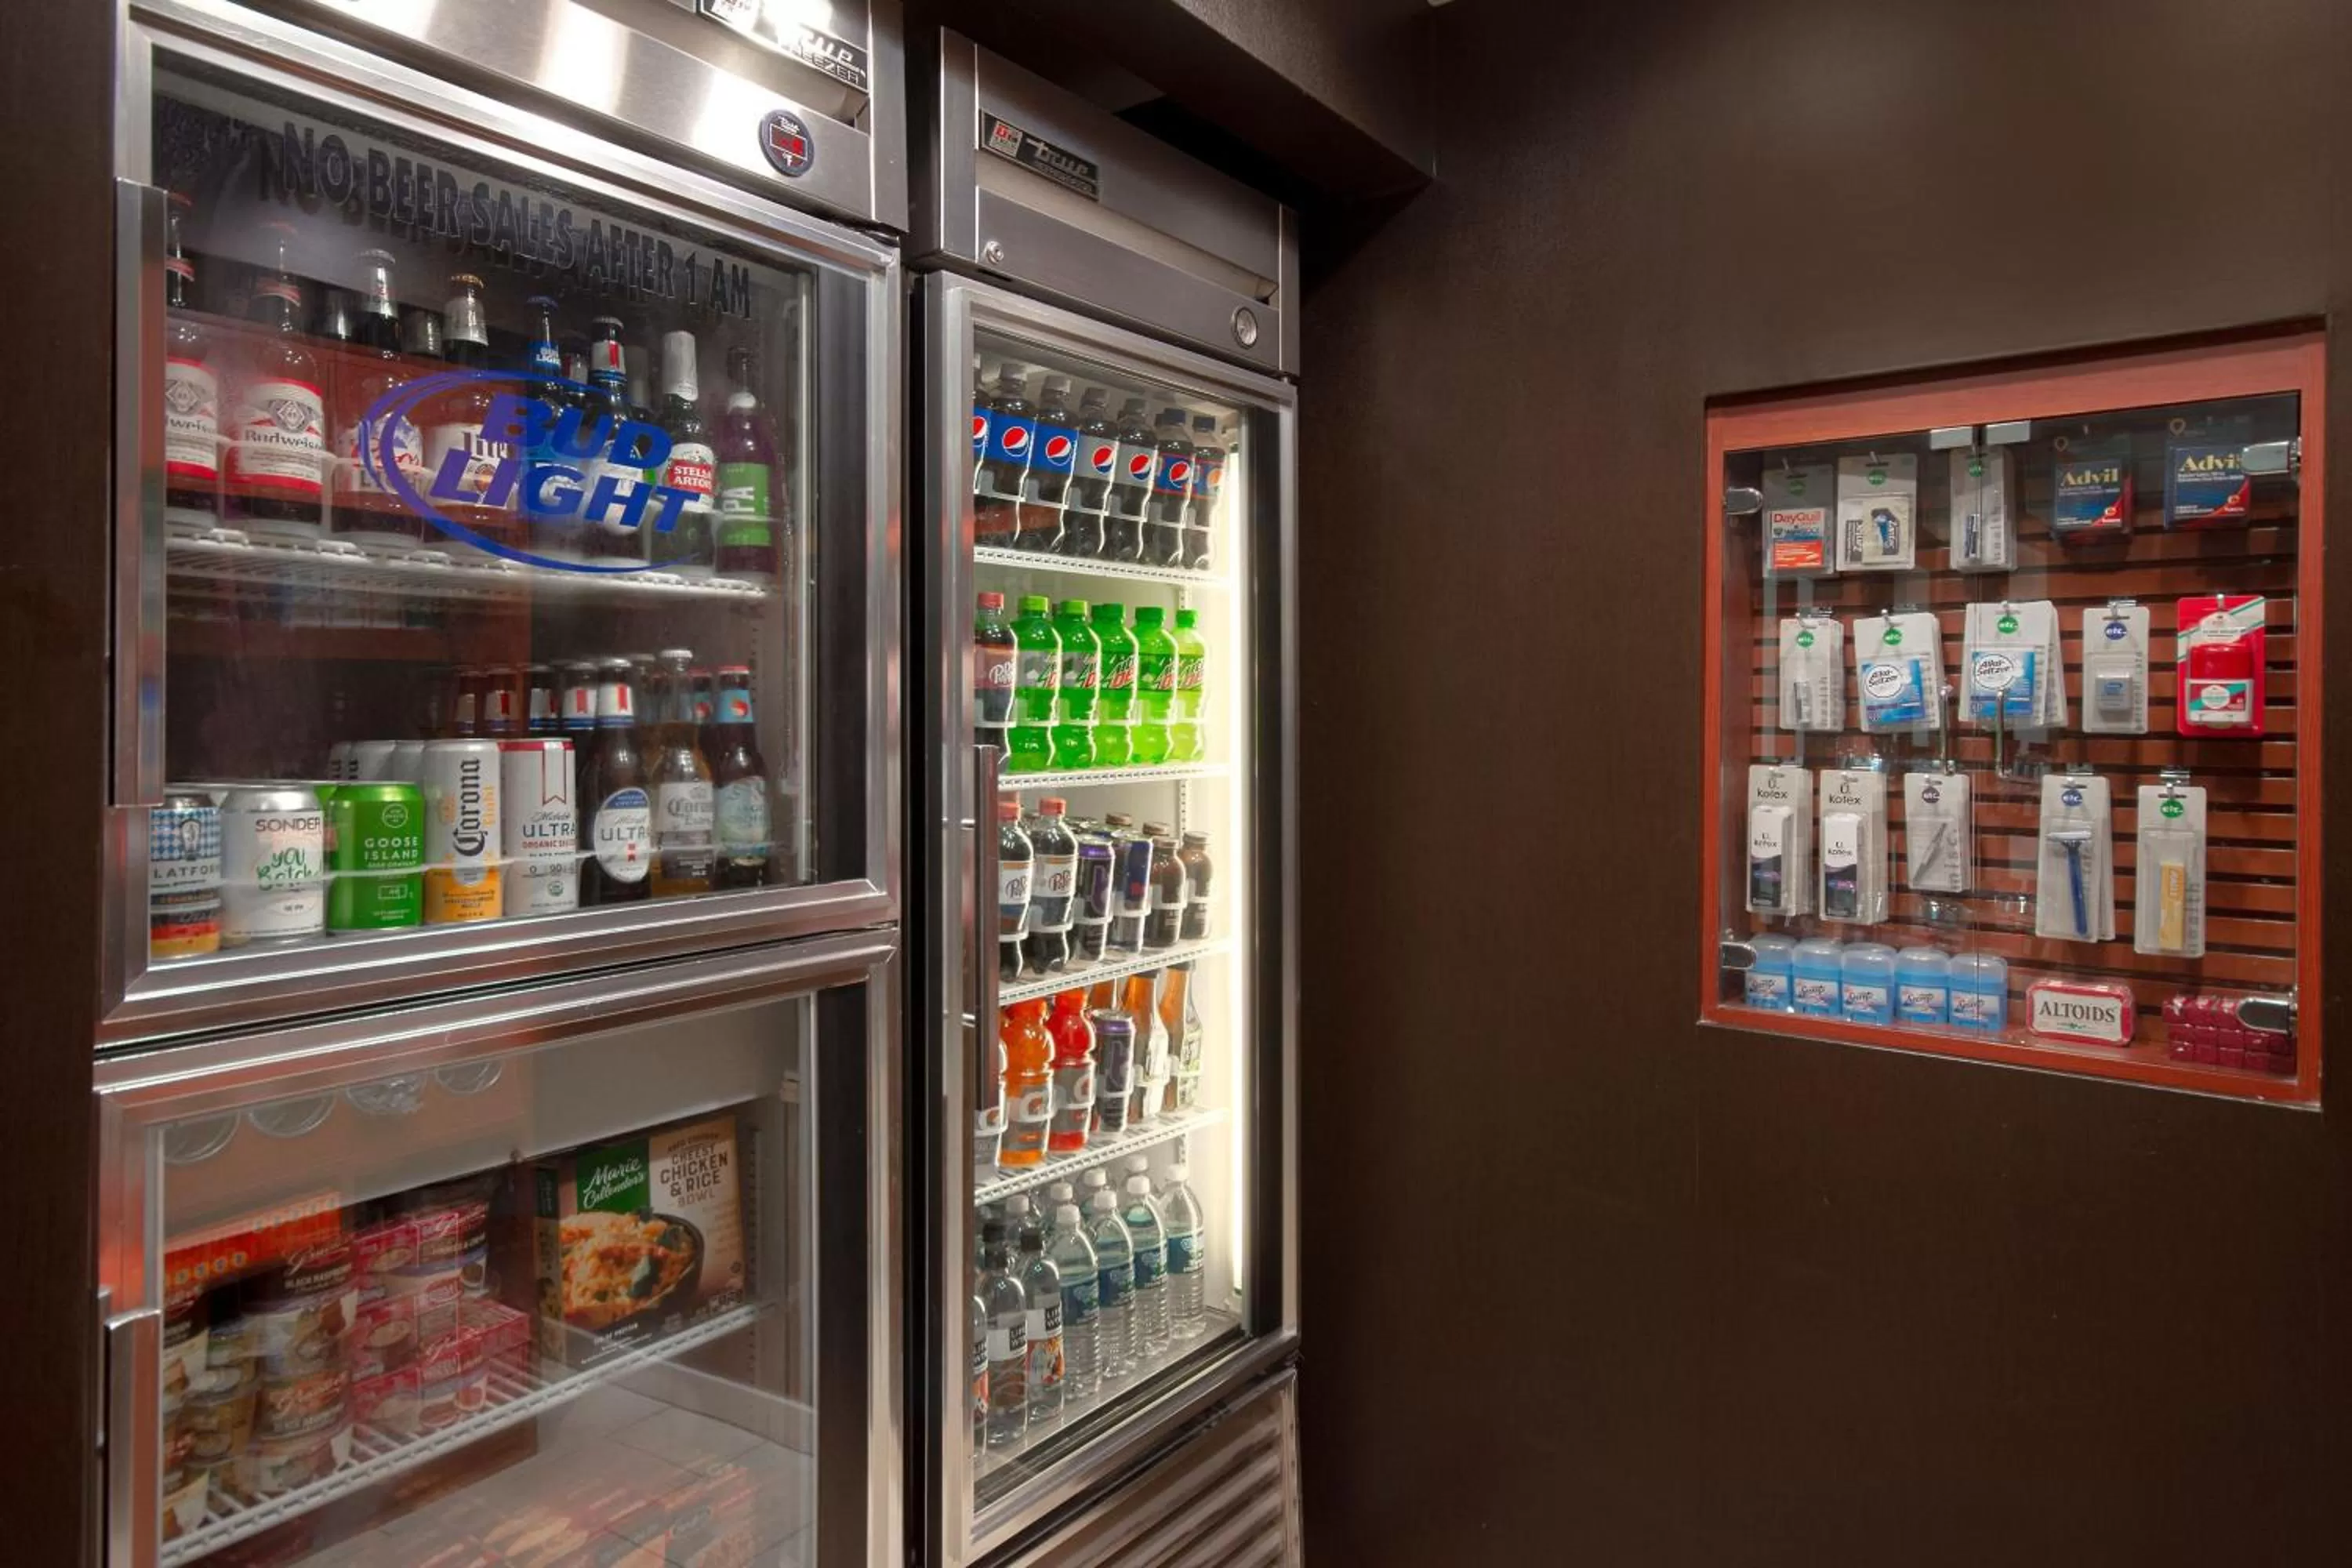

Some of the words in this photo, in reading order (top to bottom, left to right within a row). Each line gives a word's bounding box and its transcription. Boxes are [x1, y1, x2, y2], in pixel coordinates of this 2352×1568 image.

[283, 122, 354, 206] NO
[367, 147, 462, 238] BEER
[470, 182, 575, 270] SALES
[586, 219, 676, 299] AFTER
[685, 251, 699, 305] 1
[710, 257, 751, 321] AM
[479, 393, 674, 470] BUD
[429, 447, 702, 533] LIGHT
[2060, 467, 2119, 487] Advil
[452, 758, 488, 857] Corona
[363, 849, 419, 862] ISLAND
[364, 837, 419, 849] GOOSE
[2038, 1000, 2116, 1023] ALTOIDS
[660, 1151, 729, 1185] CHICKEN
[686, 1169, 721, 1192] RICE
